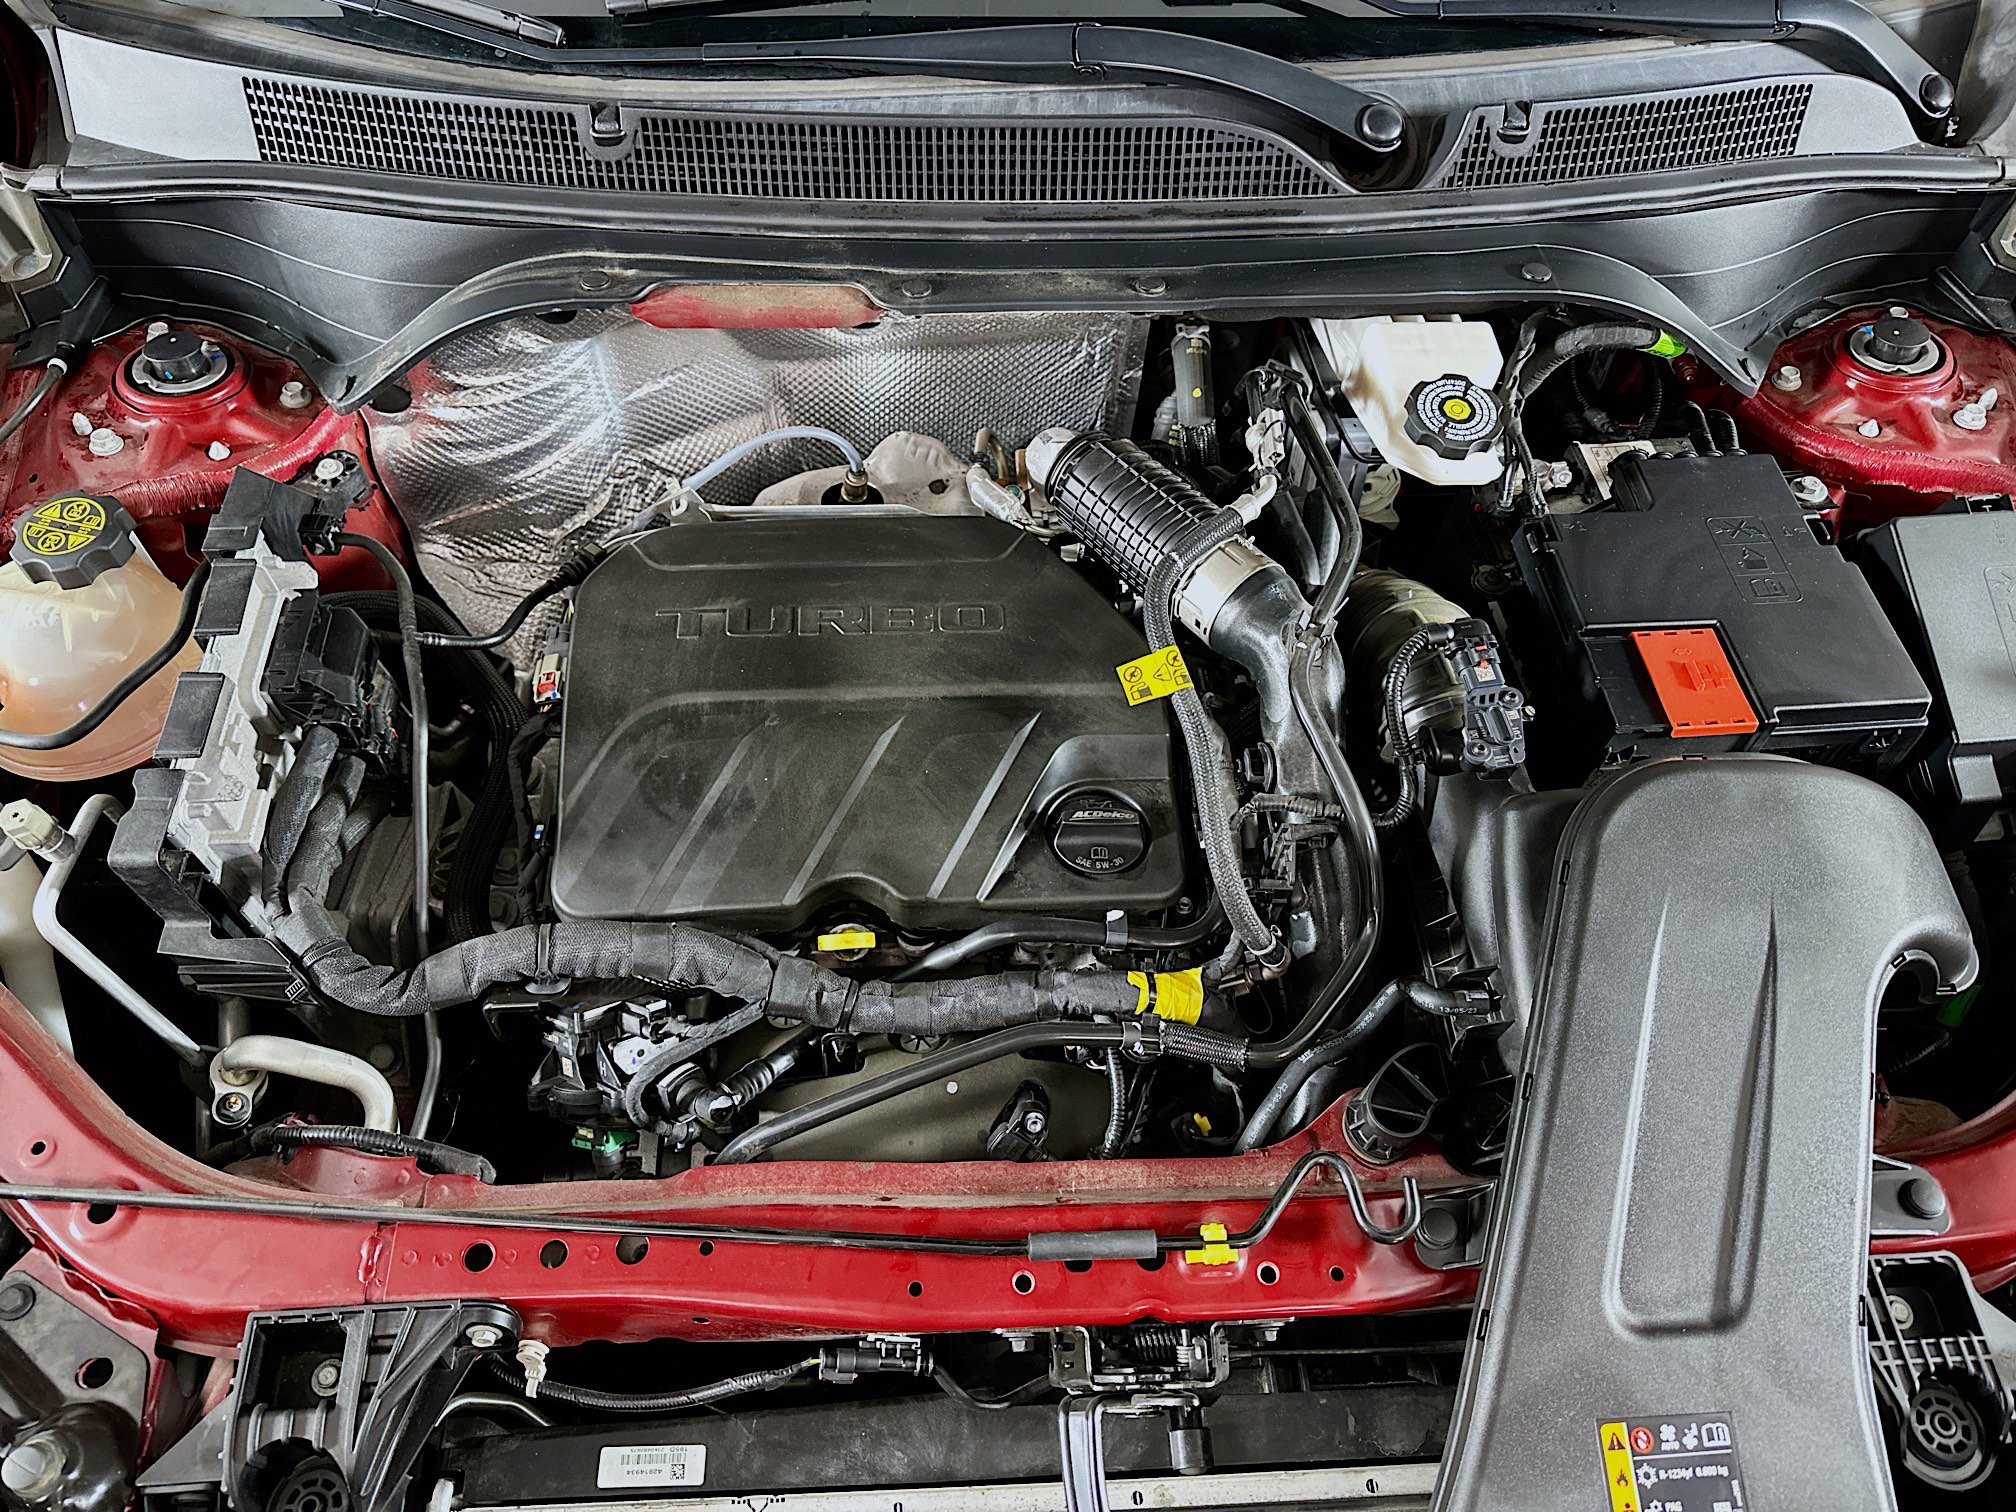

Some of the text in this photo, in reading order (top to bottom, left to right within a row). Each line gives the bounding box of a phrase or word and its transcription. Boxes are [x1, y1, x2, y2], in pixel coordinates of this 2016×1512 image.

[655, 602, 1004, 638] TURBO
[1071, 810, 1135, 819] ACDelco
[1075, 856, 1124, 869] SAE 5W-30
